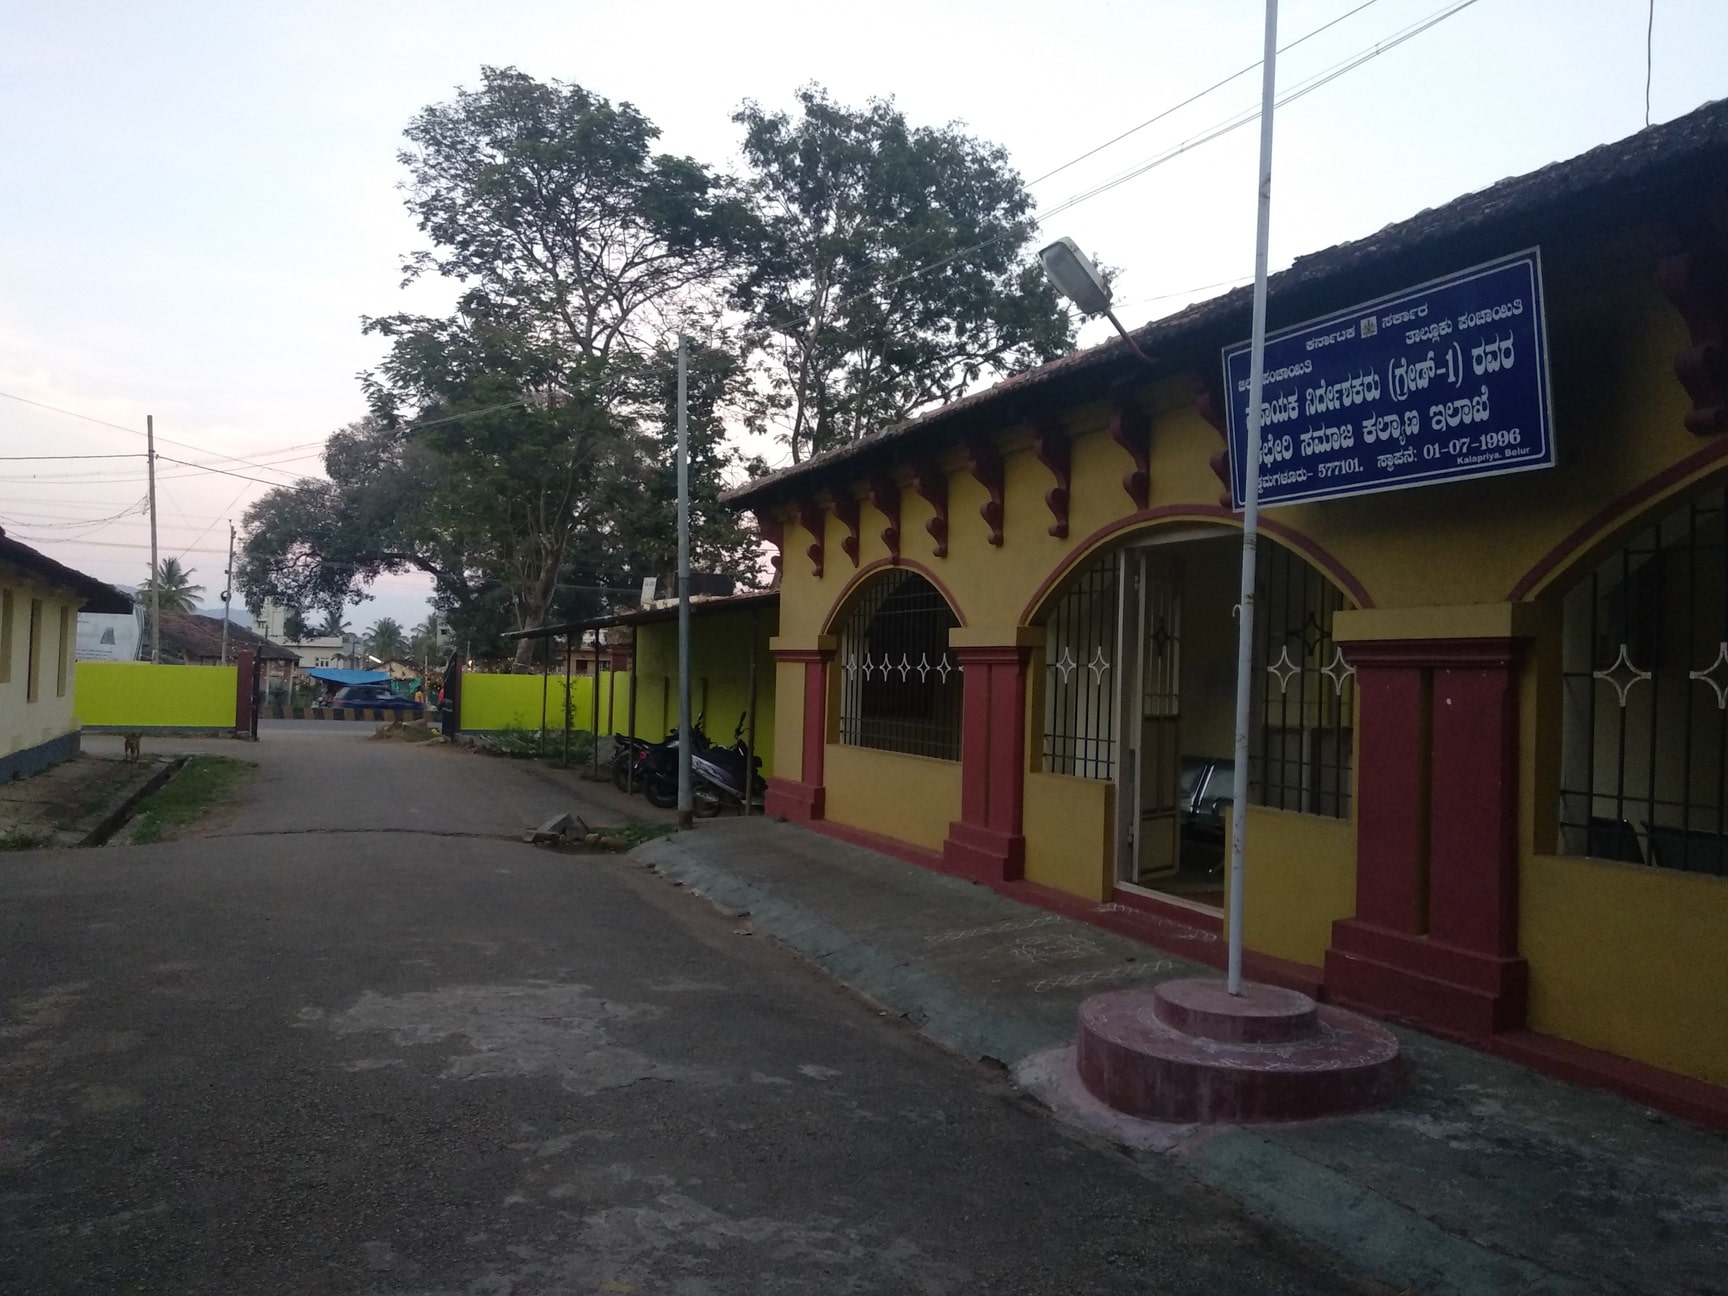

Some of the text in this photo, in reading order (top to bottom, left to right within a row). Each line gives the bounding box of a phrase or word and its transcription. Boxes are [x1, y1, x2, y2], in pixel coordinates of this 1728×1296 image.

[1306, 302, 1429, 351] ಕರ್ನಾಟಕ ಸರ್ಕಾರ
[1405, 316, 1453, 345] ತಾಲ್ಲೂಕು
[1305, 366, 1381, 416] ನಿರ್ದೇಶಕರು
[1388, 341, 1463, 402] (ಗ್ರೇಡ್-1)
[1471, 329, 1515, 375] ರವರ
[1300, 421, 1355, 457] ಸಮಾಜ
[1361, 411, 1420, 446] ಕಲ್ಯಾಣ
[1429, 384, 1490, 432] ಇಲಾಖೆ
[1318, 456, 1364, 479] 577101.
[1423, 428, 1521, 460] 01-07-1996
[1504, 446, 1531, 458] Belur
